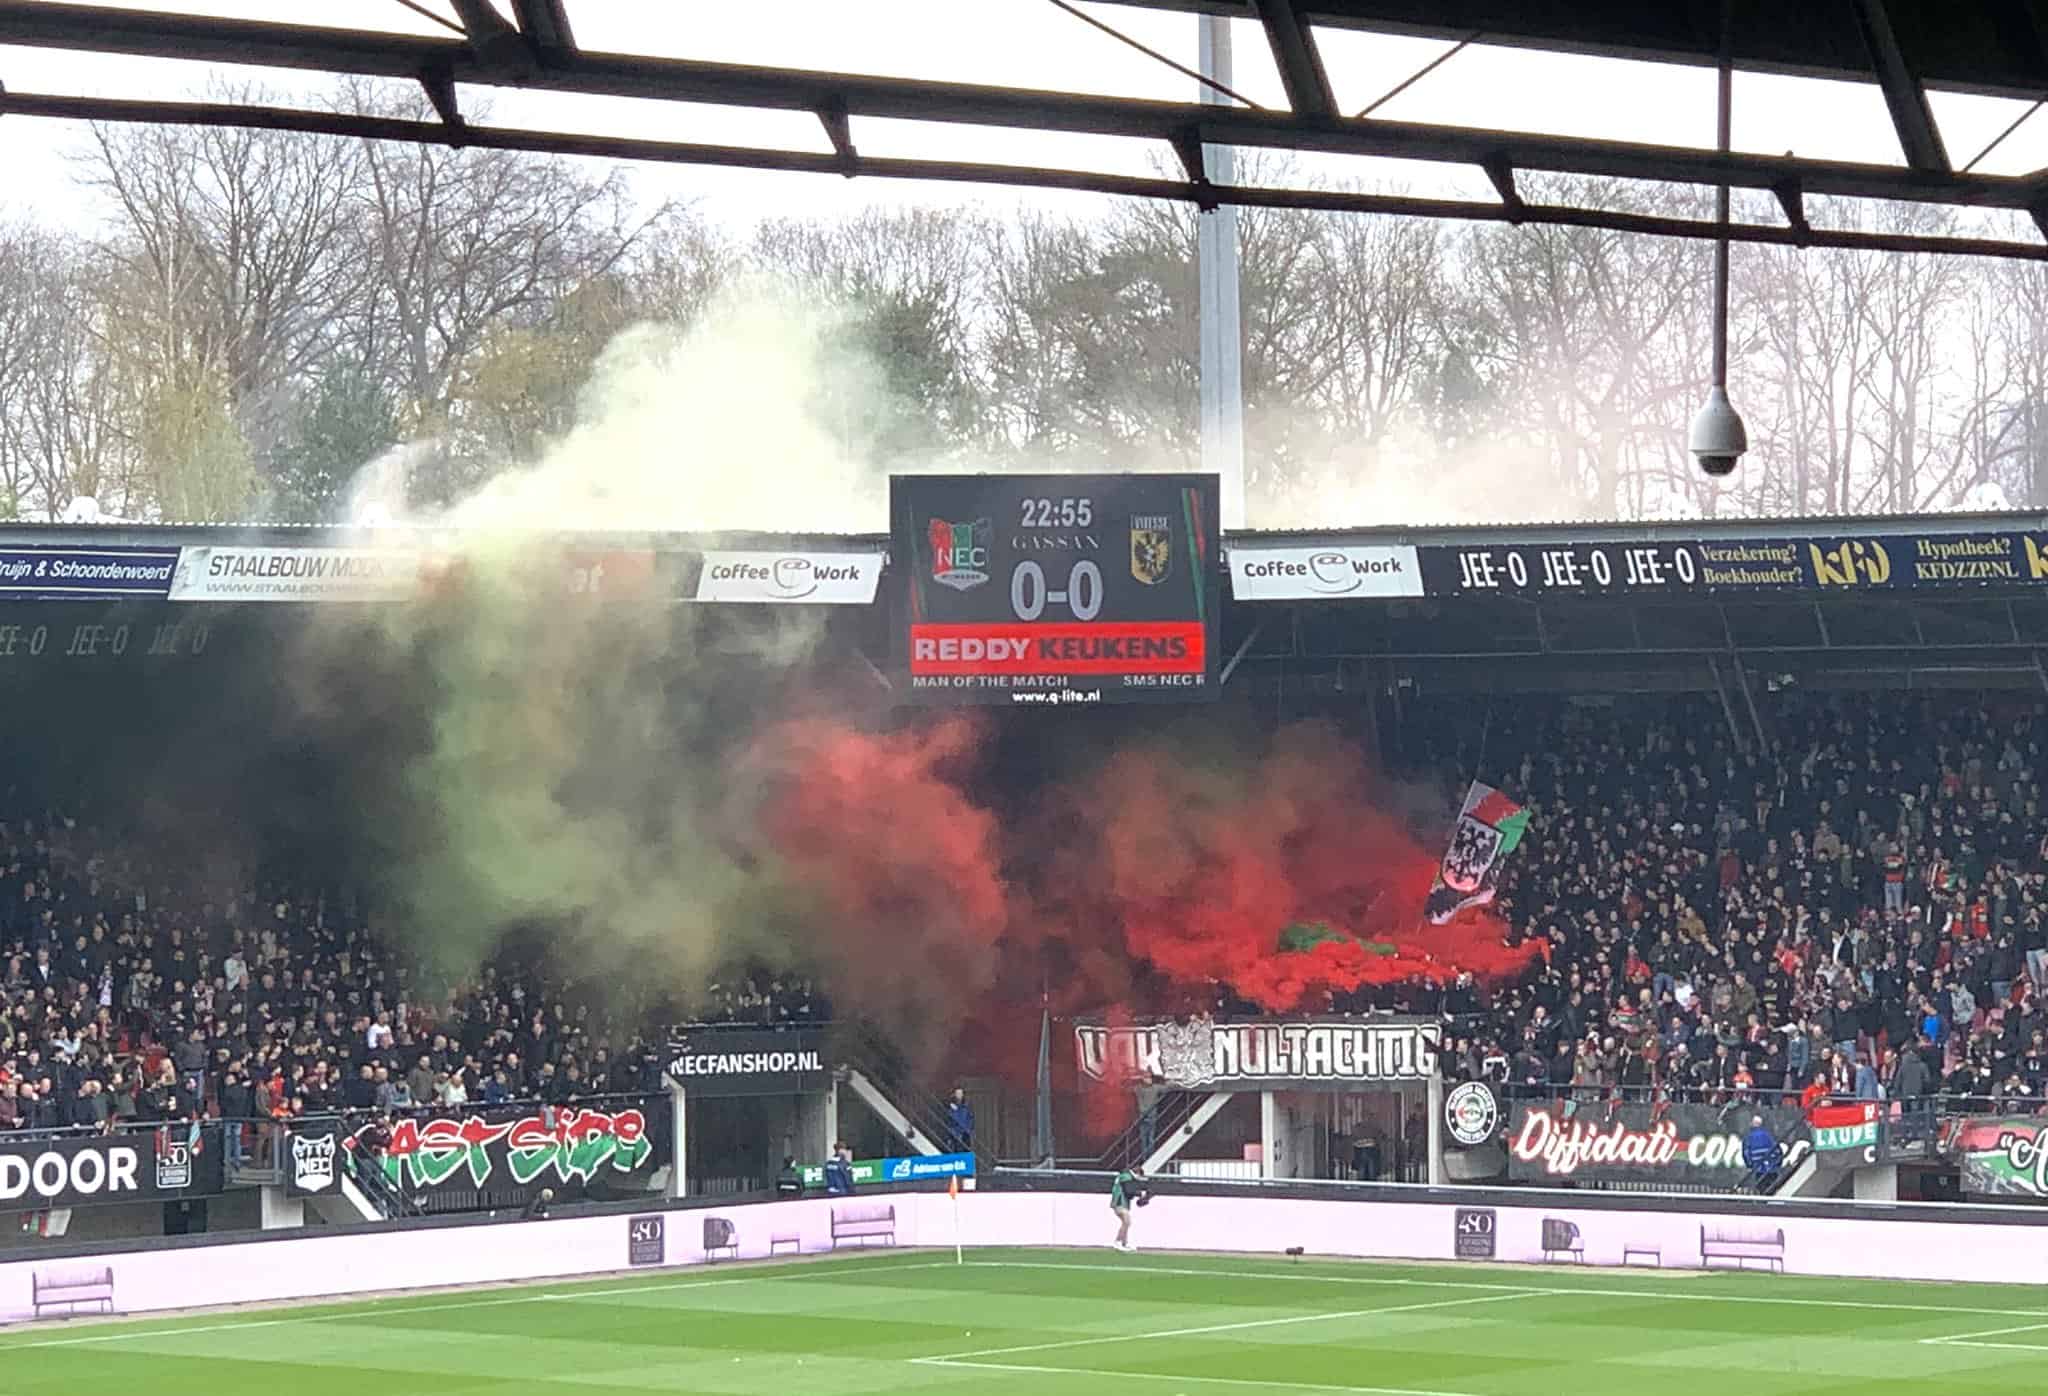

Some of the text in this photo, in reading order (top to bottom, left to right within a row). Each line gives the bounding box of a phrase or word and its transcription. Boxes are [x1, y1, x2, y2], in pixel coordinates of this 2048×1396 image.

[1021, 499, 1092, 527] 22:55
[937, 547, 986, 567] NEC
[1699, 543, 1797, 564] Verzekering?
[1917, 538, 2011, 560] Hypotheek?
[0, 559, 172, 581] ruijn & Schoonderwoerd
[208, 555, 329, 577] STAALBOUW
[711, 563, 861, 582] Coffee Work
[1244, 557, 1402, 577] Coffee Work
[1459, 548, 1695, 588] JEE-O JEE-O JEE-O
[1702, 566, 1803, 585] Boekhouder?
[1011, 560, 1104, 621] 0-0
[914, 637, 1186, 660] REDDY KEUKENS
[912, 676, 950, 688] MAN
[953, 676, 976, 688] OF
[977, 676, 1009, 687] THE
[1013, 675, 1068, 687] MATCH
[1123, 674, 1157, 686] SMS
[1160, 674, 1193, 686] NEC
[1012, 688, 1101, 704] www.q-lite.nl
[670, 1051, 823, 1075] NECFANSHOP.NL
[0, 1147, 138, 1199] DOOR
